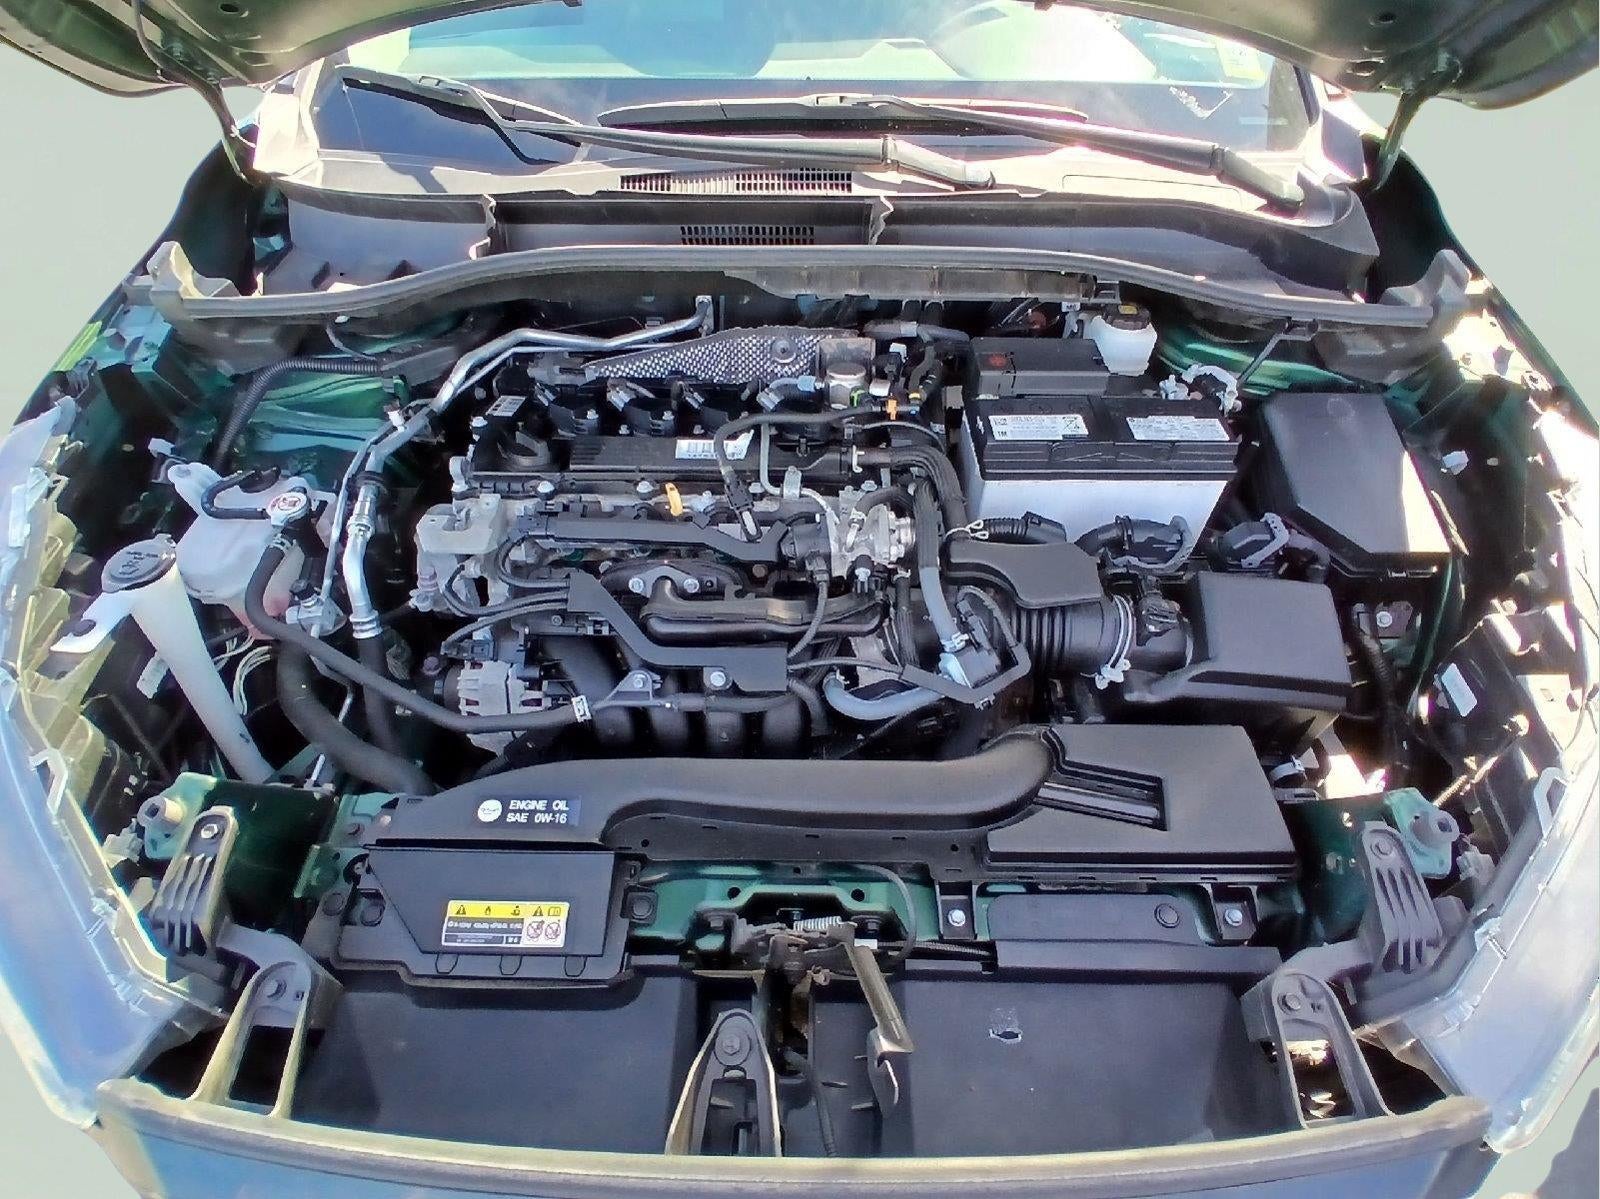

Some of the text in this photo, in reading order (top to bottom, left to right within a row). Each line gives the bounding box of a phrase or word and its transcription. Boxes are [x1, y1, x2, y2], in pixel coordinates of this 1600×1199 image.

[508, 799, 570, 811] ENGINE OIL
[506, 812, 568, 824] SAE 0W-16
